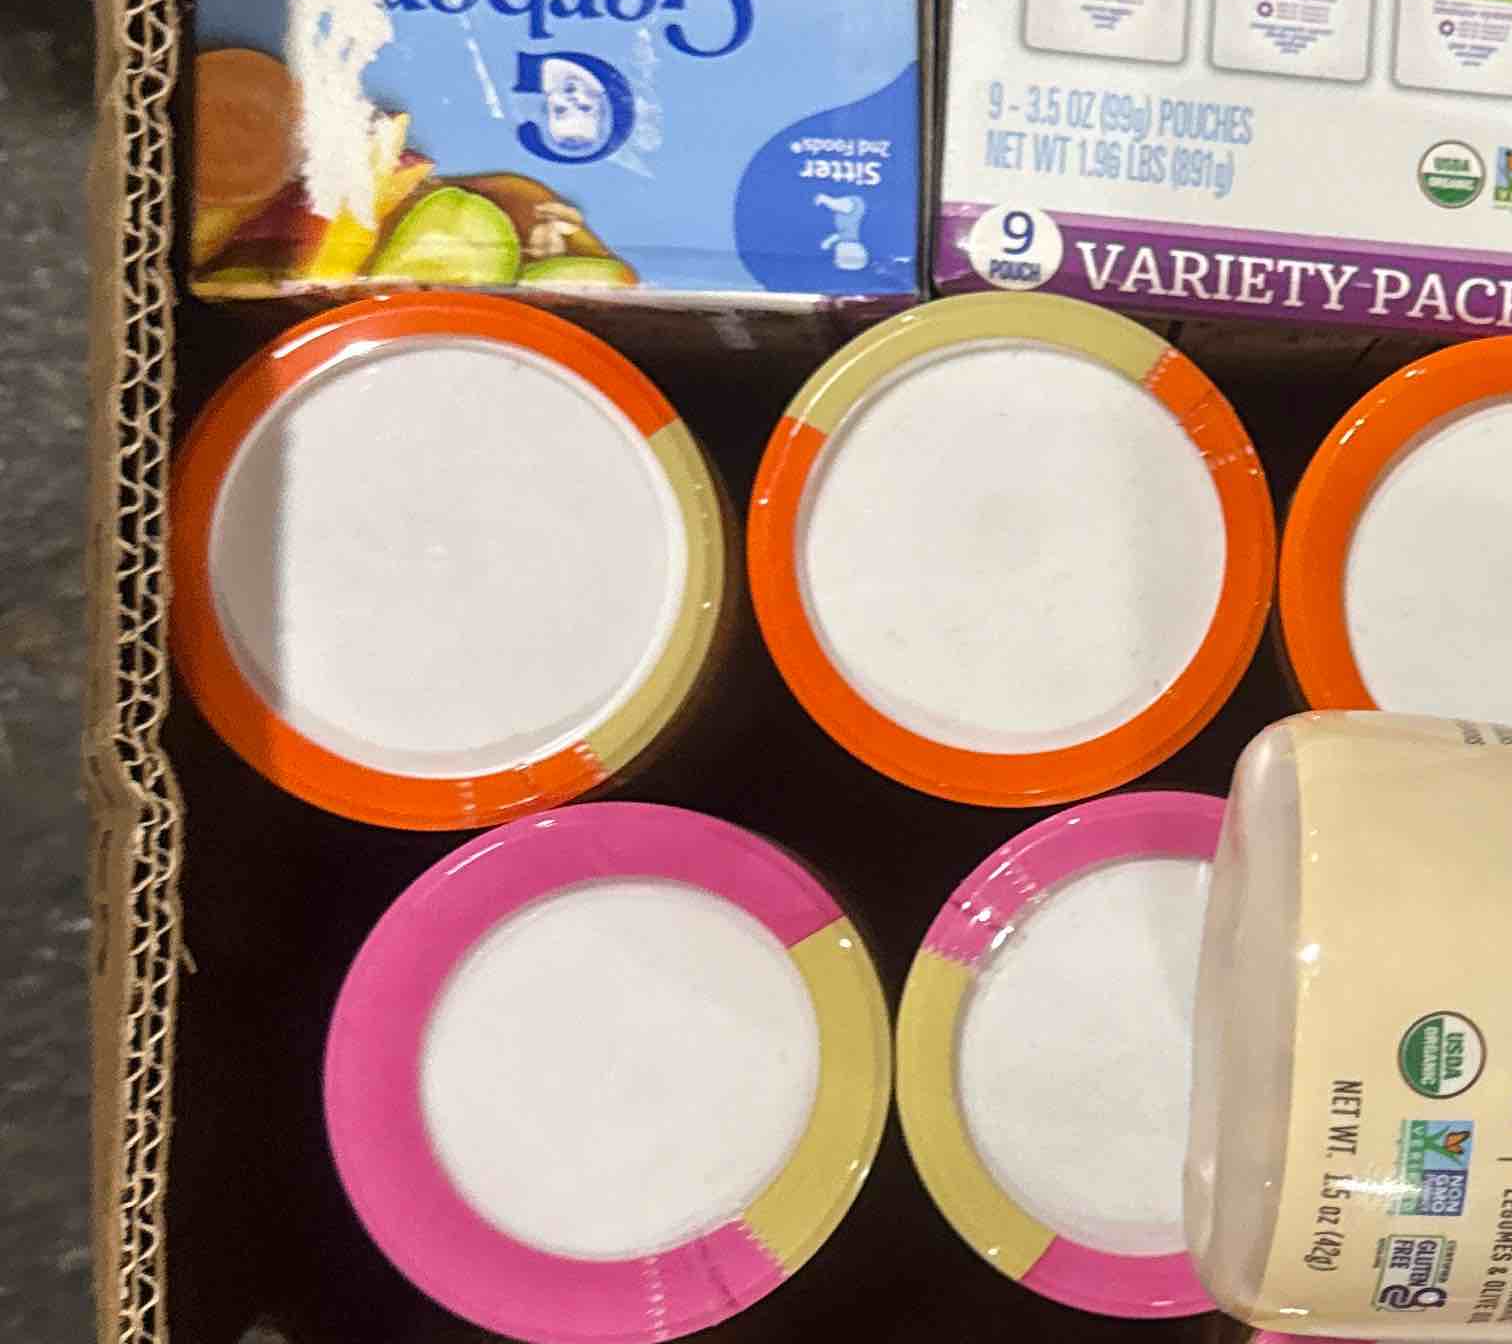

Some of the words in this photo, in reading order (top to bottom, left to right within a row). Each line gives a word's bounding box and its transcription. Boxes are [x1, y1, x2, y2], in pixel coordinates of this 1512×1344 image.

[799, 159, 882, 188] Sitter
[1001, 211, 1037, 256] 9
[988, 257, 1042, 282] POUCH
[1074, 239, 1360, 312] VARIETY
[1418, 1025, 1441, 1087] ORGANIC
[1442, 1031, 1467, 1081] USDA
[1332, 1079, 1364, 1120] NET
[1326, 1123, 1359, 1159] WT.
[1430, 1172, 1449, 1214] GMO
[1444, 1174, 1465, 1213] NON
[1309, 1230, 1344, 1272] (42g)
[1388, 1238, 1415, 1271] FREE
[1409, 1239, 1439, 1288] GLUTEN
[1486, 1265, 1508, 1276] &
[1474, 1279, 1507, 1311] OLIVE
